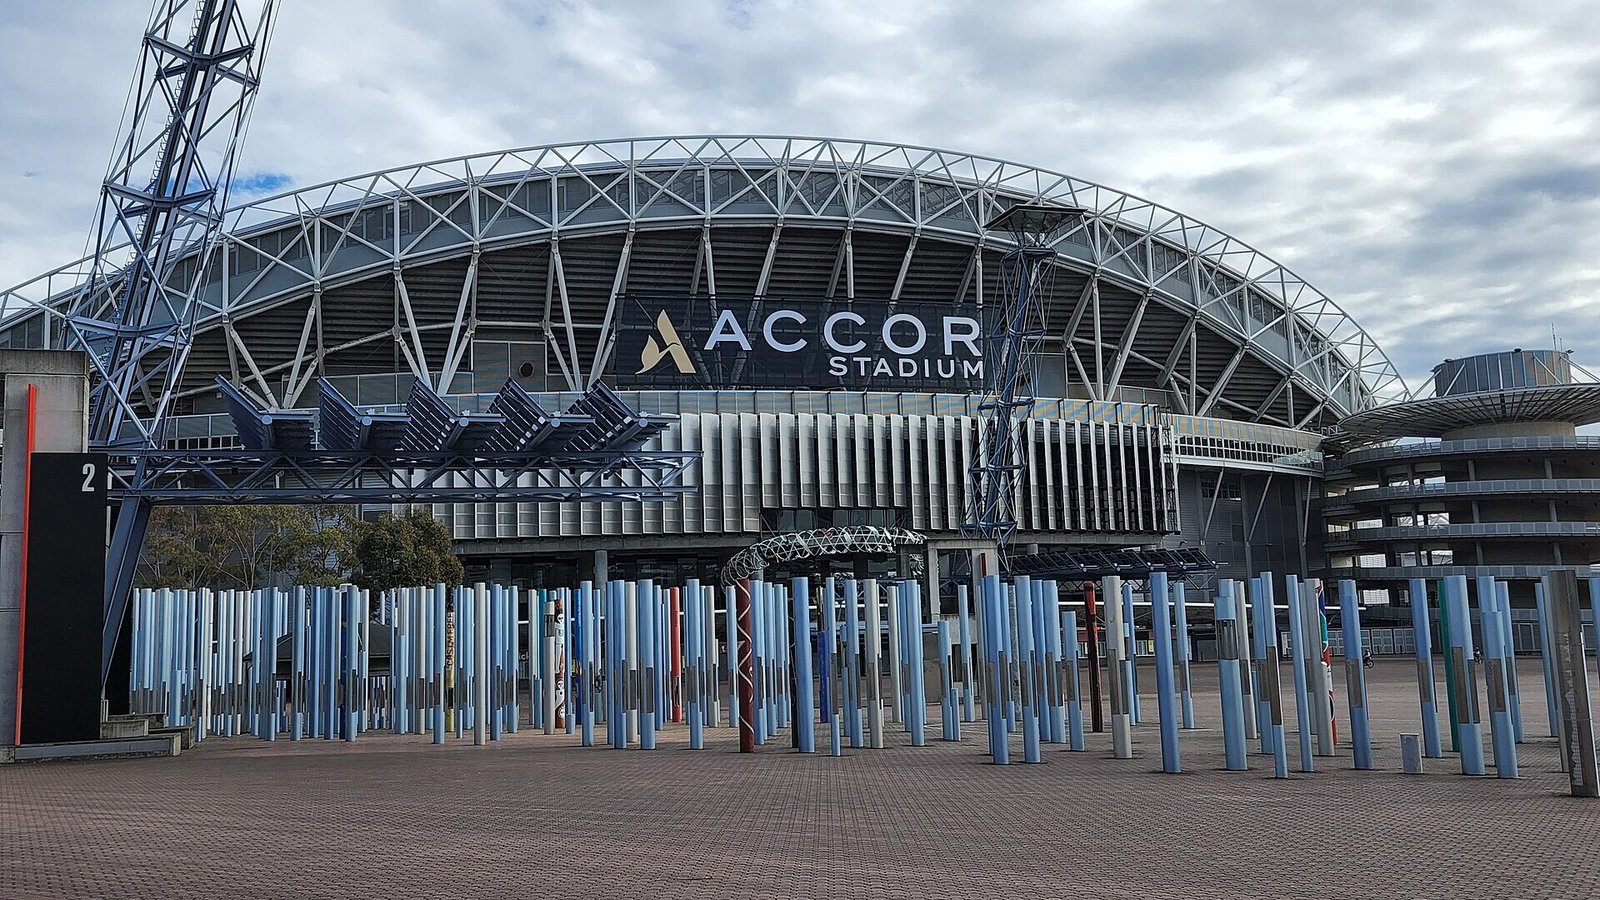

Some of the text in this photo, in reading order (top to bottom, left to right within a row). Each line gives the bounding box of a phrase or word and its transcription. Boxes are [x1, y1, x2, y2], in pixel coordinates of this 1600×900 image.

[704, 309, 983, 356] ACCOR
[829, 356, 983, 379] STADIUM
[82, 463, 95, 492] 2
